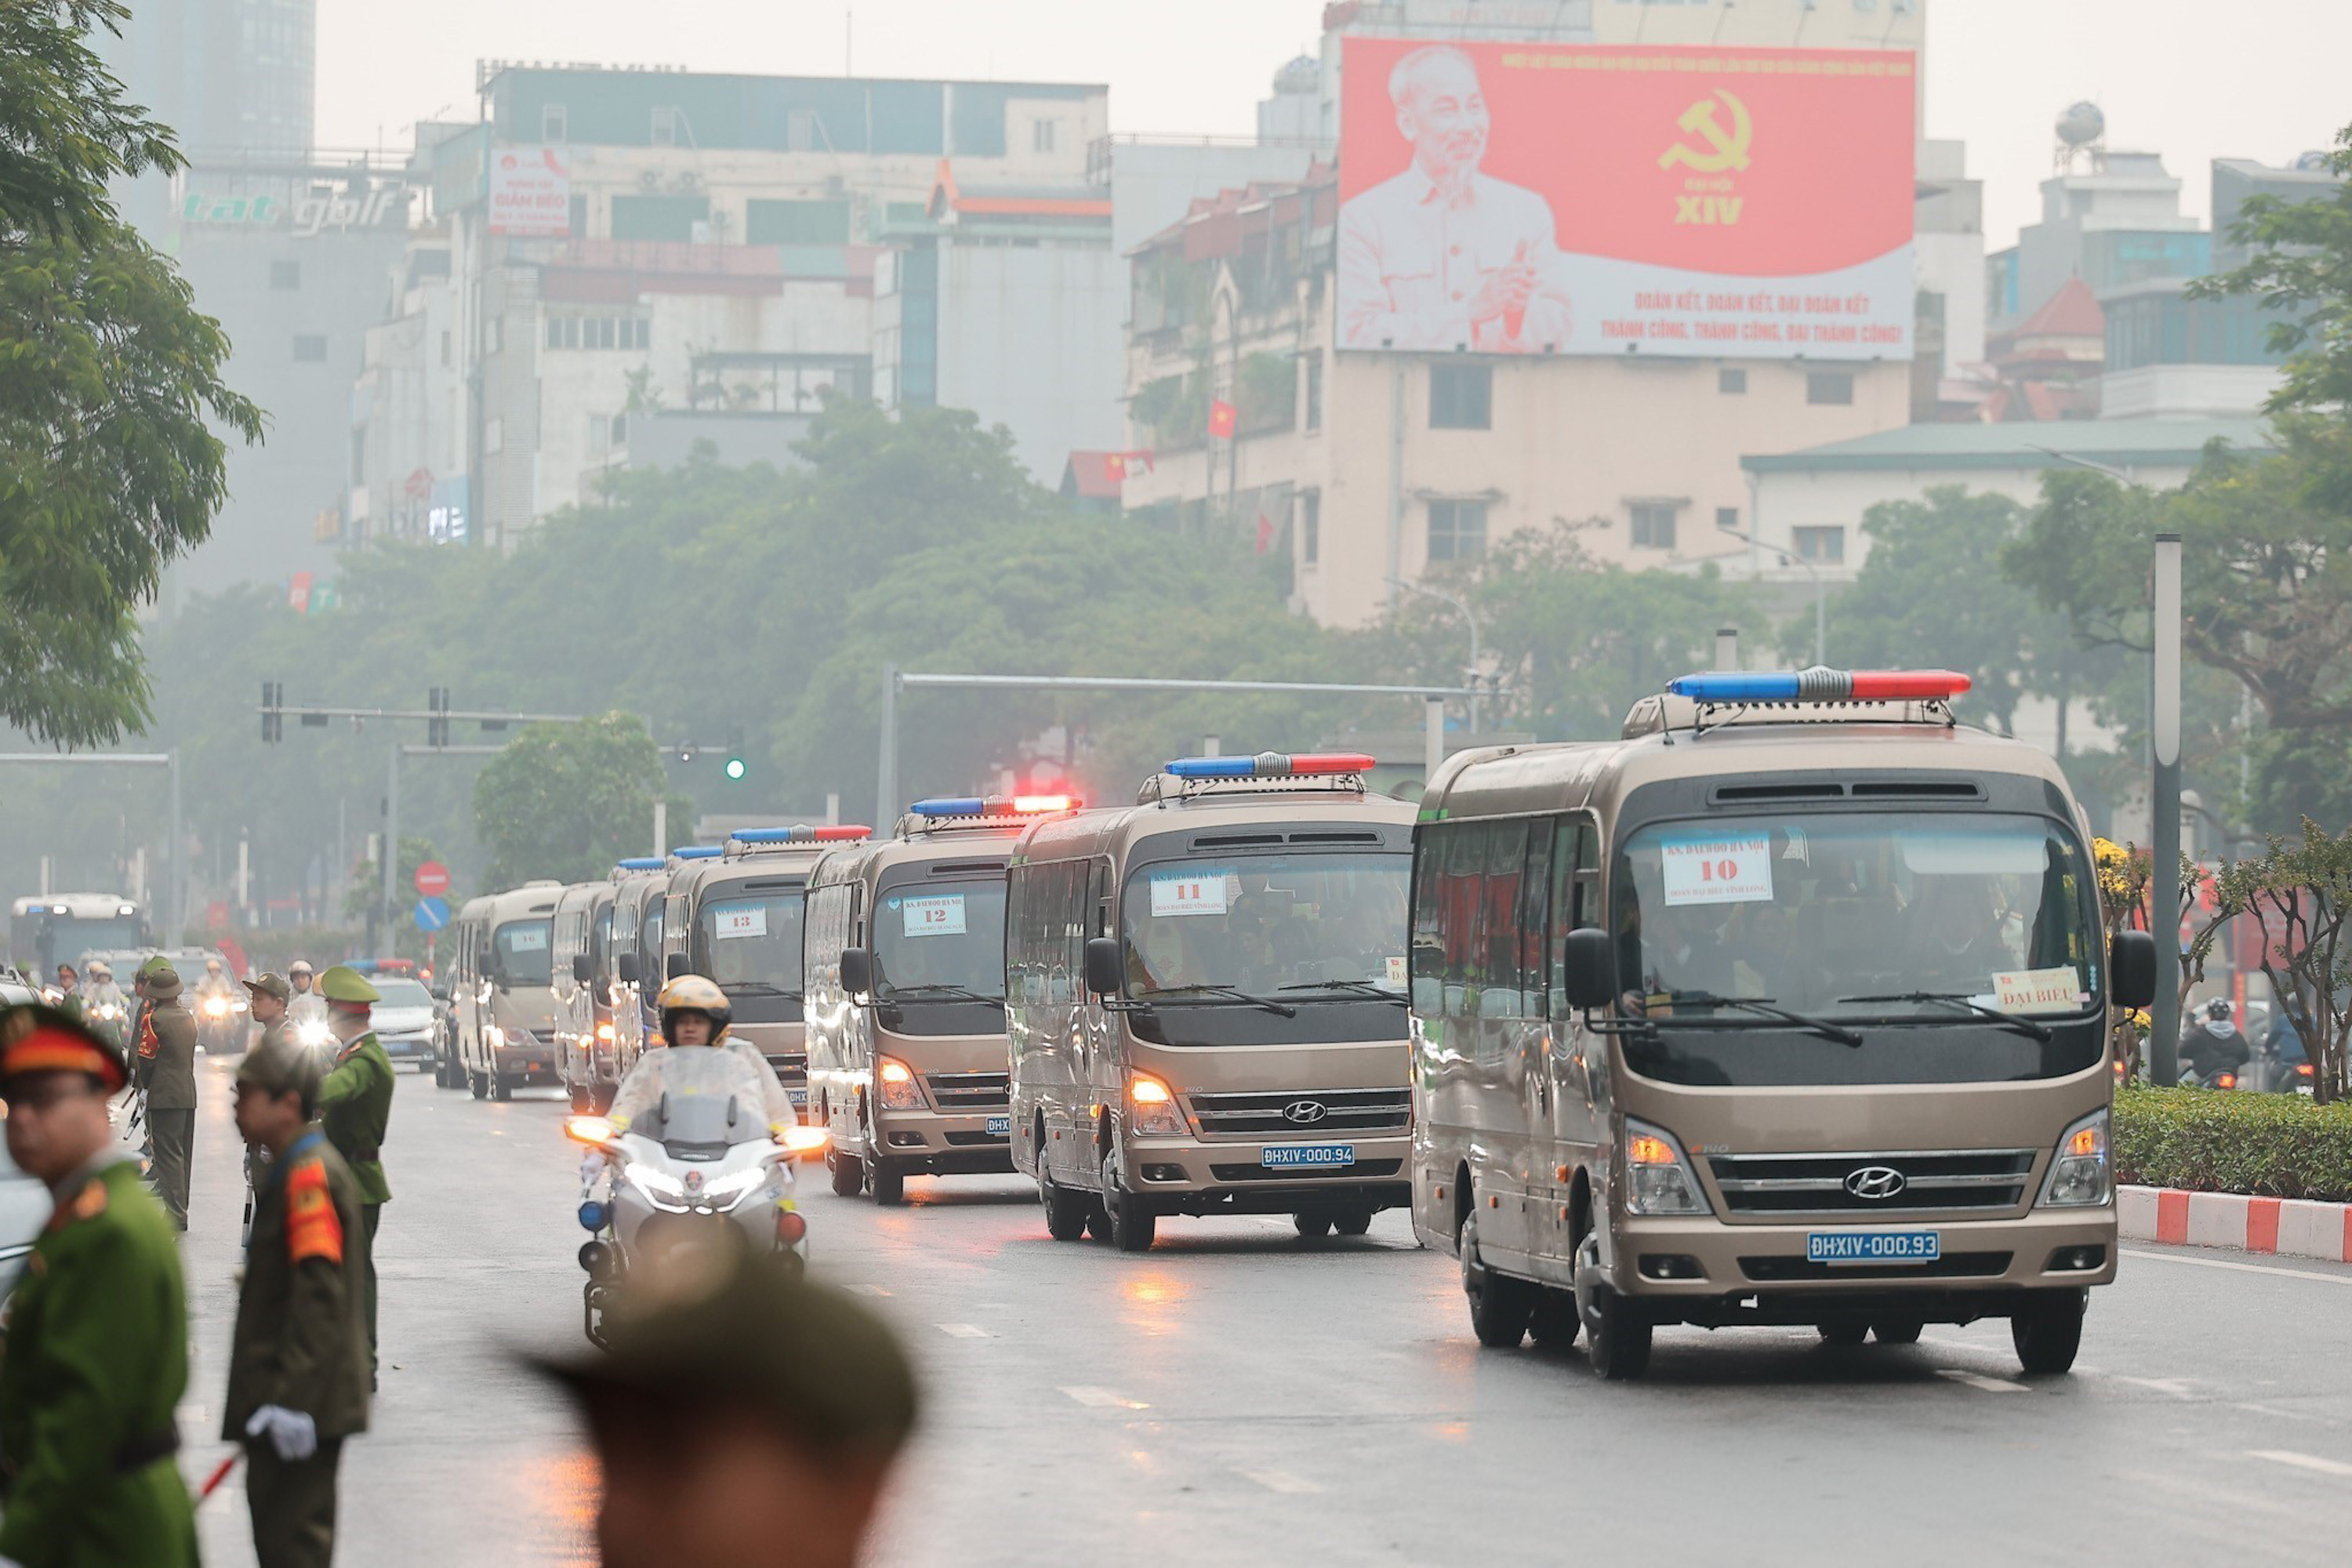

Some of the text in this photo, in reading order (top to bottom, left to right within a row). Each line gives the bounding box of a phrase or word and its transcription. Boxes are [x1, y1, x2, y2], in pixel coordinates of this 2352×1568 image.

[291, 191, 395, 238] golf
[1675, 195, 1742, 224] XIV
[1701, 860, 1737, 880] 10
[1177, 884, 1200, 899] 11
[734, 916, 750, 927] 13
[925, 909, 946, 922] 12
[1811, 1235, 1936, 1255] ĐHXIV-000.93
